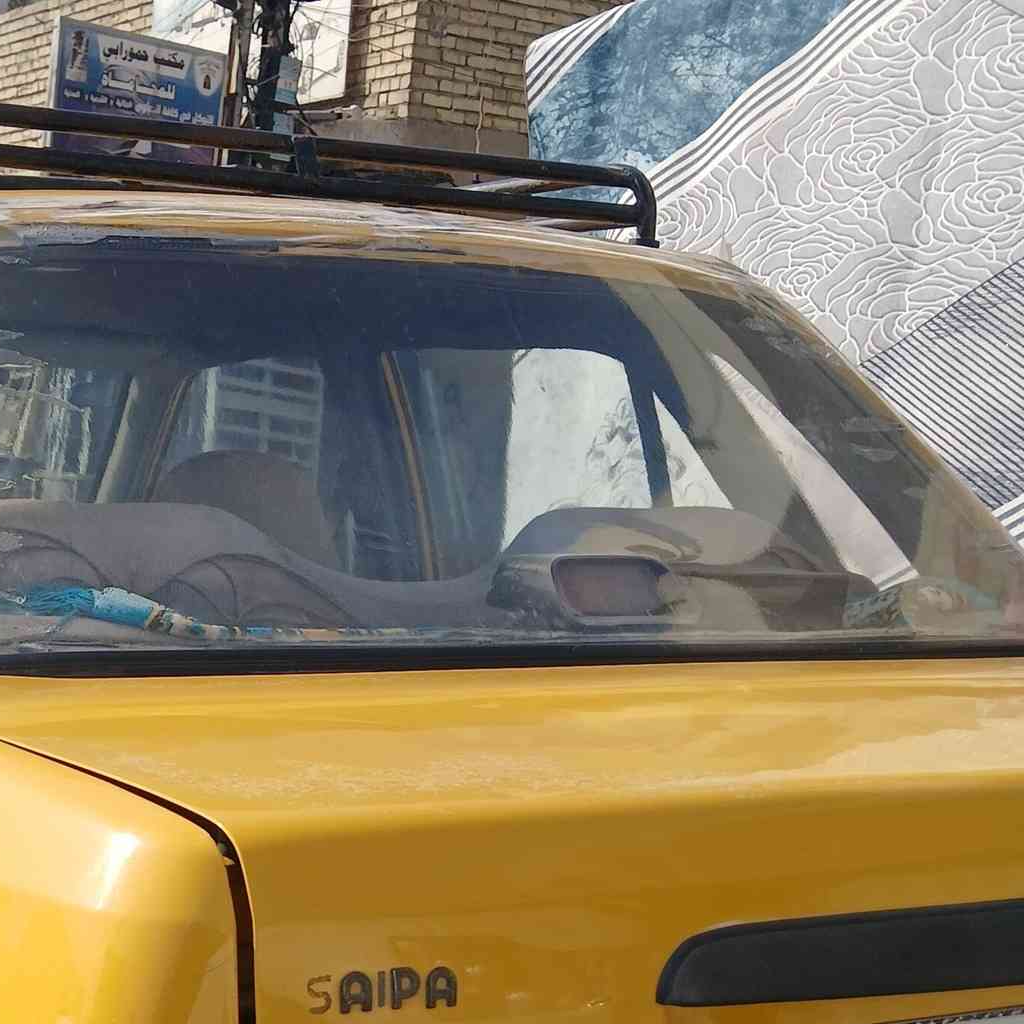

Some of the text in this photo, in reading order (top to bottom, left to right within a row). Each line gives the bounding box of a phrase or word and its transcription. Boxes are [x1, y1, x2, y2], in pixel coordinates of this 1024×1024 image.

[102, 40, 149, 63] حمورابي
[153, 51, 185, 70] مكتب
[307, 966, 458, 1015] SAIPA
